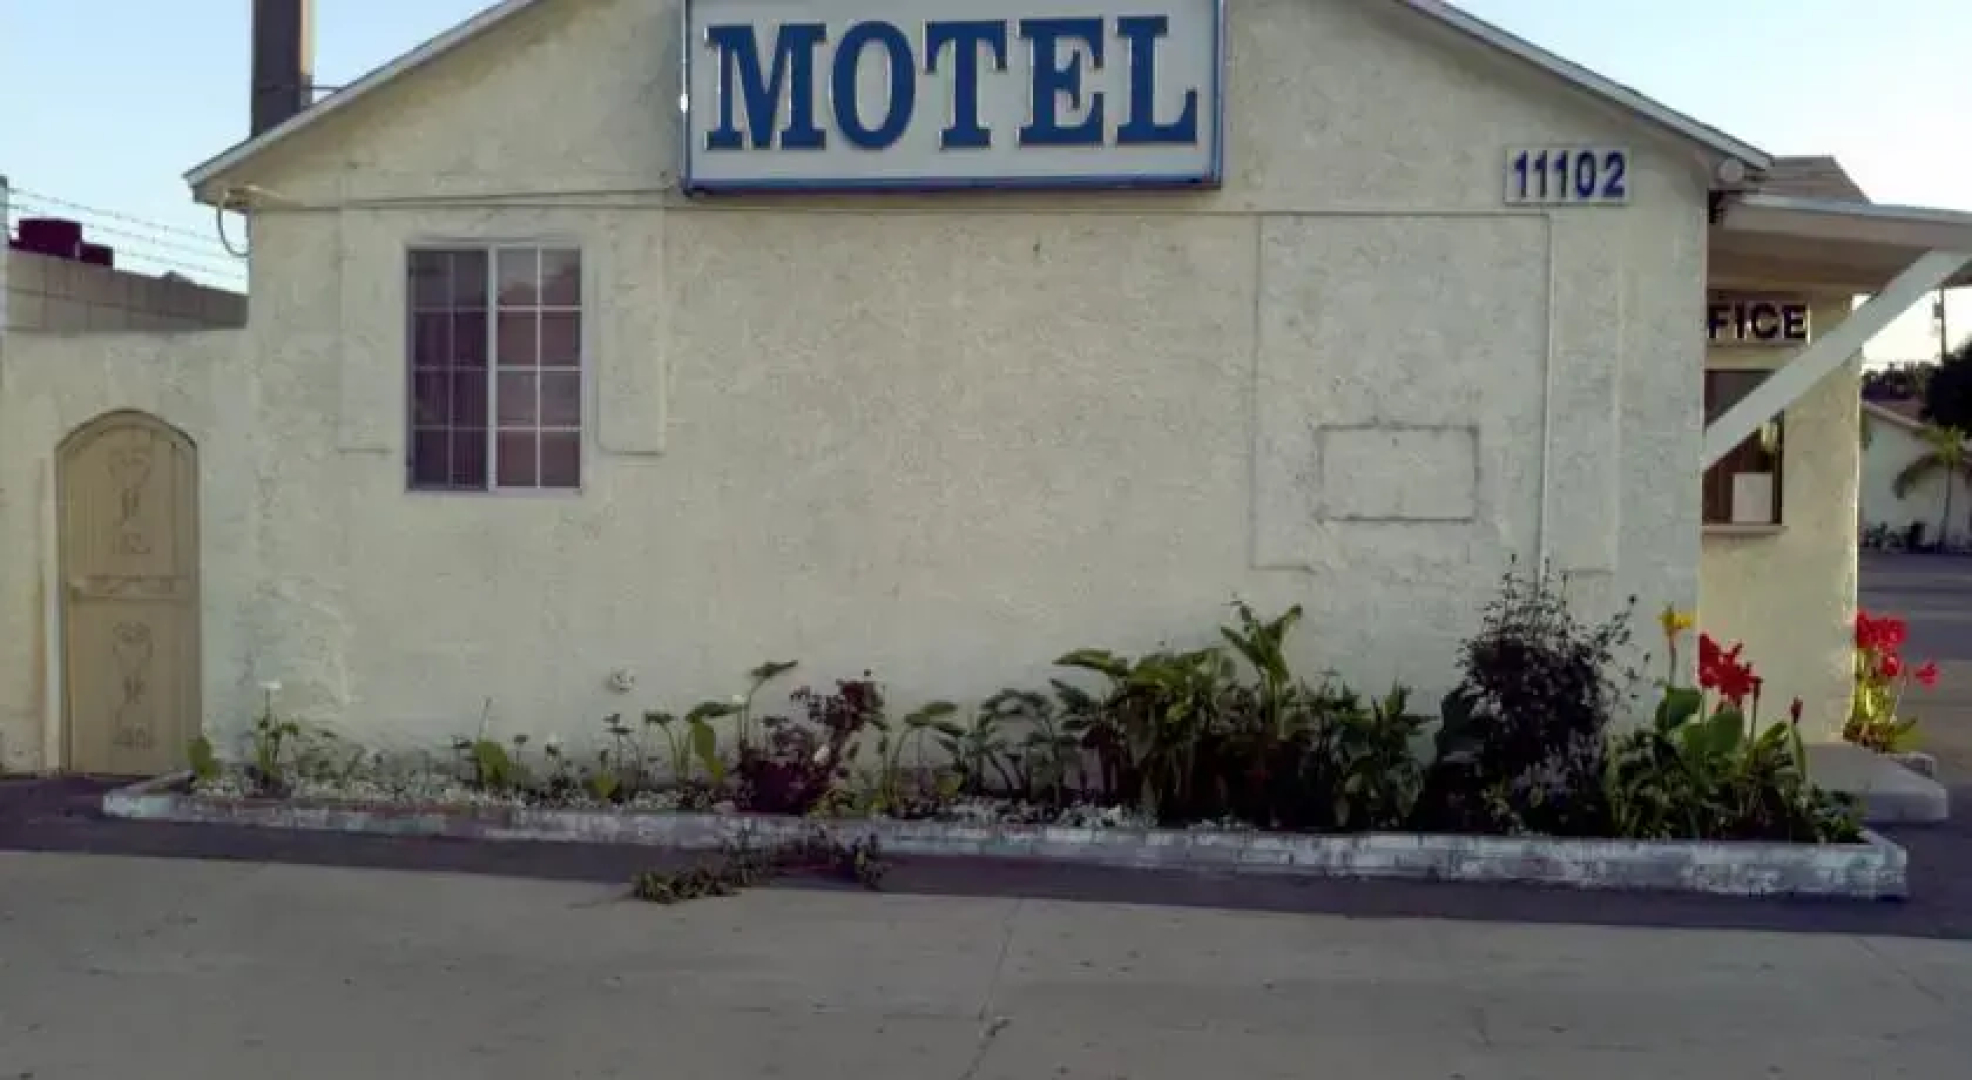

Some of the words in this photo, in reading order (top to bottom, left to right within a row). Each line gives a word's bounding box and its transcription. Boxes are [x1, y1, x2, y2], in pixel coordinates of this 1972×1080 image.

[705, 16, 1198, 150] MOTEL
[1514, 150, 1626, 198] 11102
[1707, 303, 1806, 339] FICE
